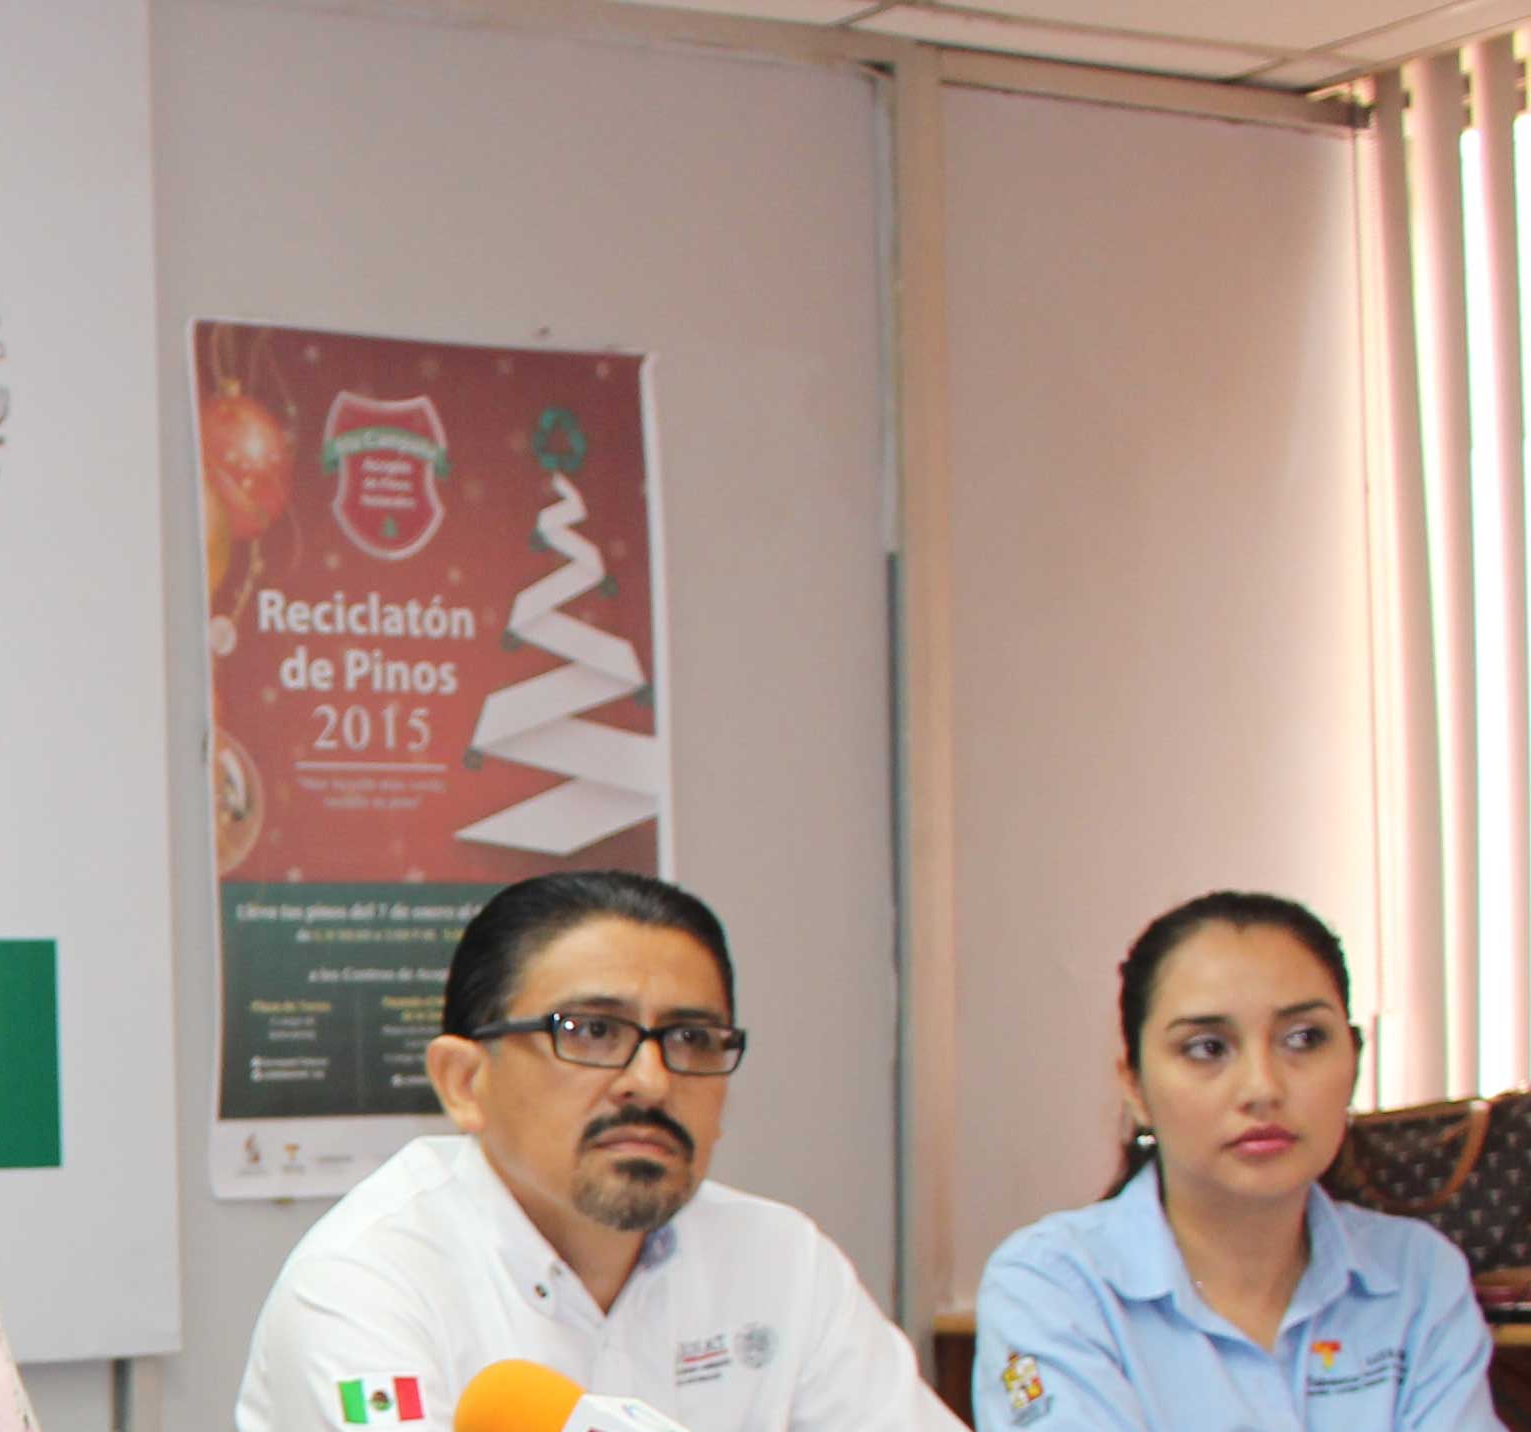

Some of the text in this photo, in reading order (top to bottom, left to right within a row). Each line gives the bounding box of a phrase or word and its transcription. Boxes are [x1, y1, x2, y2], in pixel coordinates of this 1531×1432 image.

[257, 588, 475, 639] Reciclatón
[279, 646, 458, 694] de Pinos
[313, 704, 431, 751] 2015
